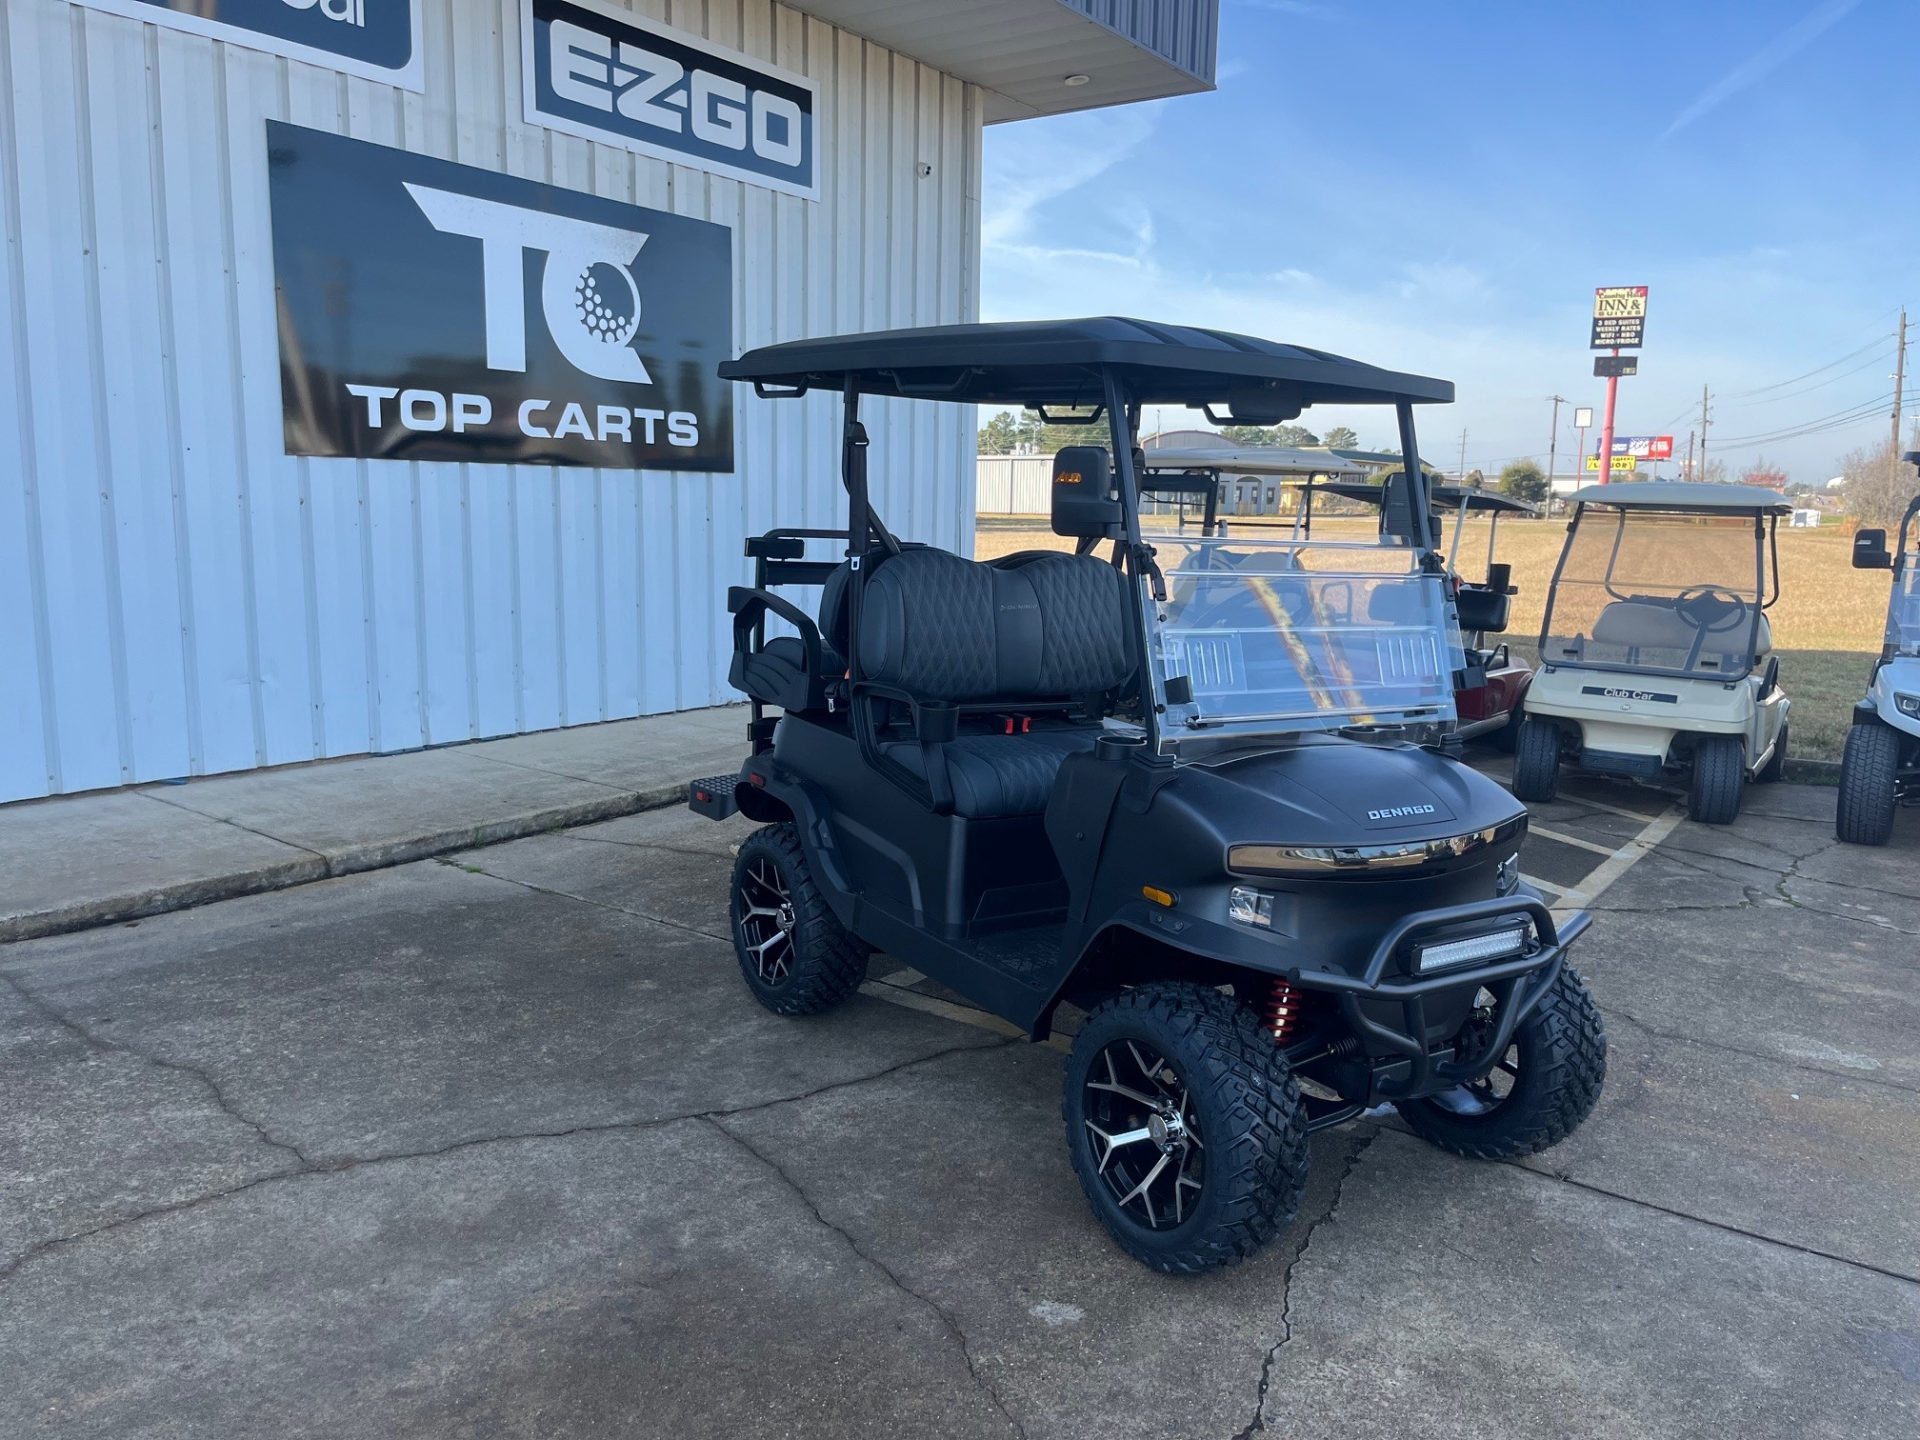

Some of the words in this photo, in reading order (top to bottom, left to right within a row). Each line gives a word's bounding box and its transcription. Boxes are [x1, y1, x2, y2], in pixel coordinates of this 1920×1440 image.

[1598, 299, 1628, 311] INN
[1630, 299, 1641, 310] &
[345, 383, 492, 433] TOP
[518, 398, 699, 447] CARTS
[1603, 688, 1629, 698] Club
[1632, 691, 1654, 700] Car
